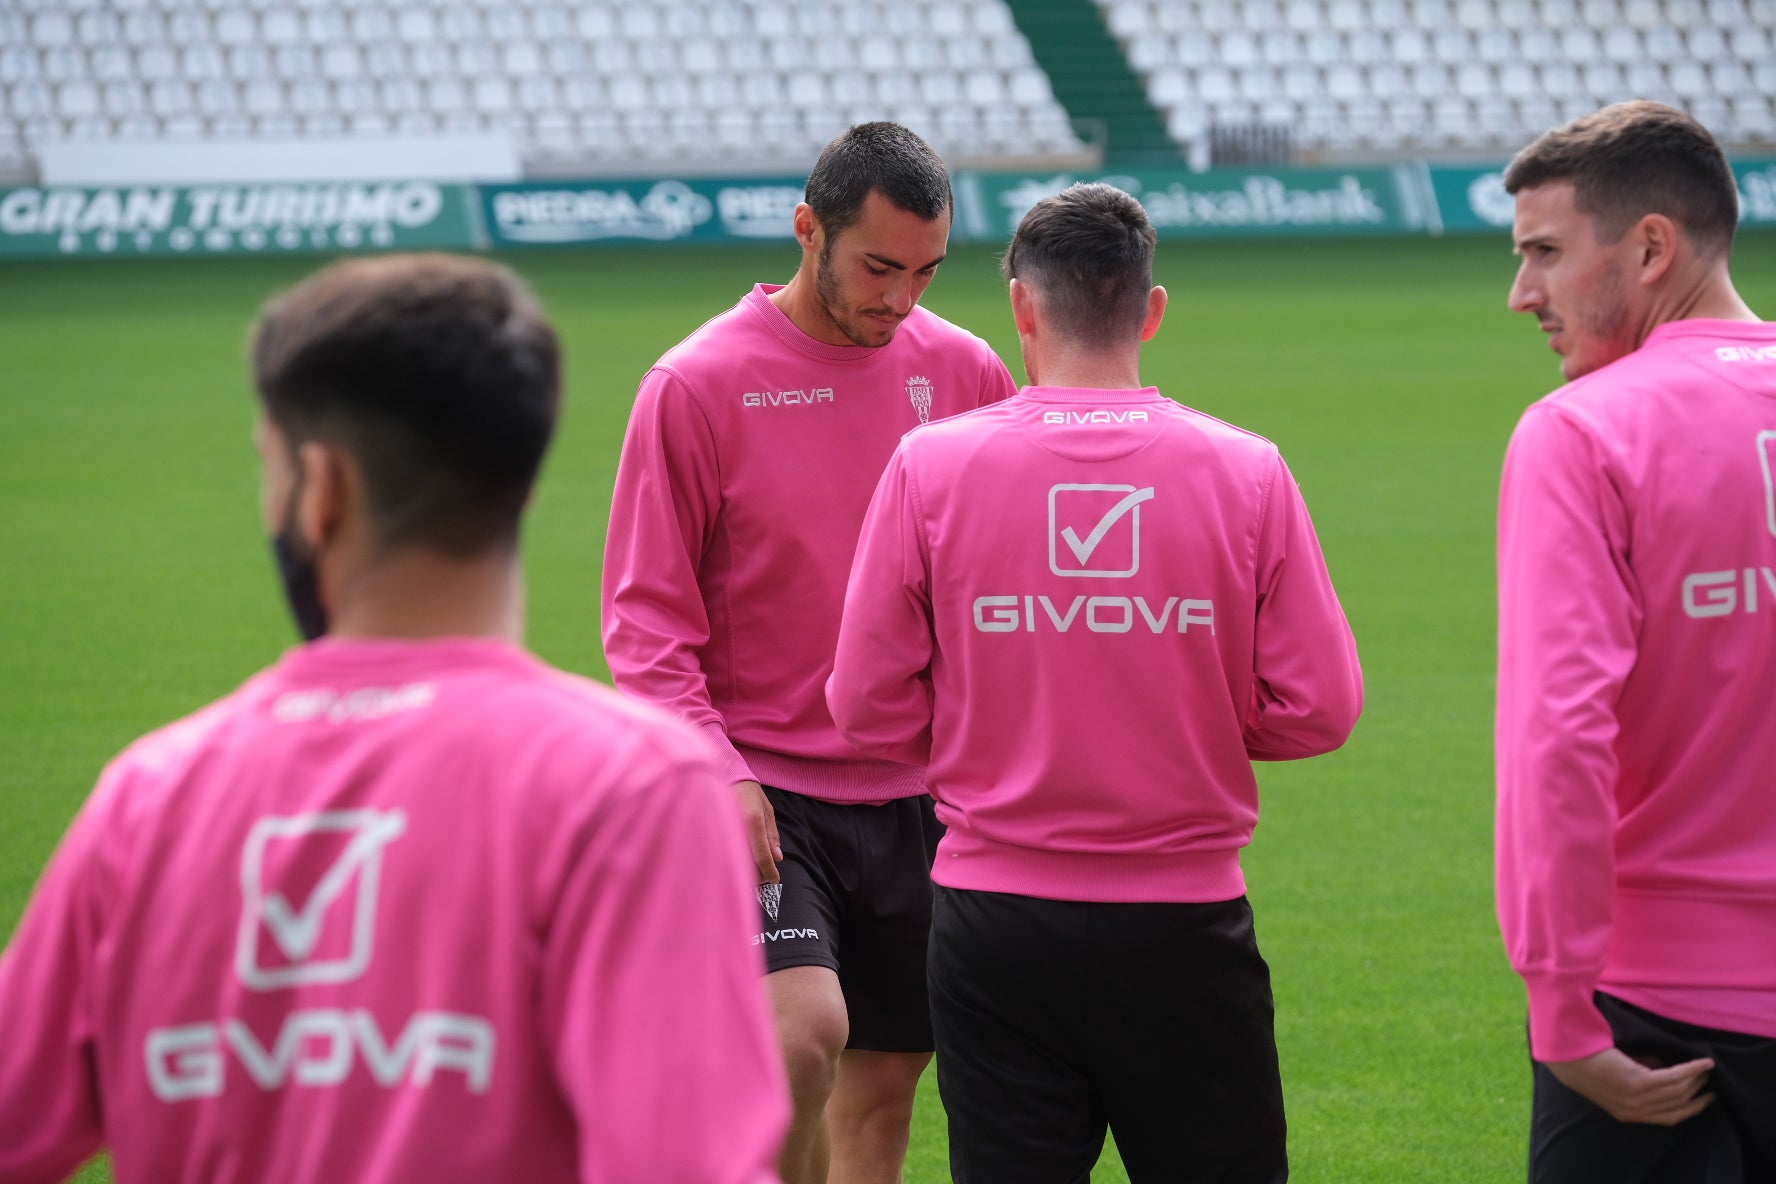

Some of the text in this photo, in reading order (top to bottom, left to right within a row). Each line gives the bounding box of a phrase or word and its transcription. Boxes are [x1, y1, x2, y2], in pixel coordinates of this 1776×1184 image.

[0, 187, 176, 233] GRAN
[1106, 174, 1384, 226] aixaBank
[743, 388, 834, 407] GIVOVA
[1043, 411, 1149, 425] GIVOVA
[973, 595, 1216, 636] GIVOVA
